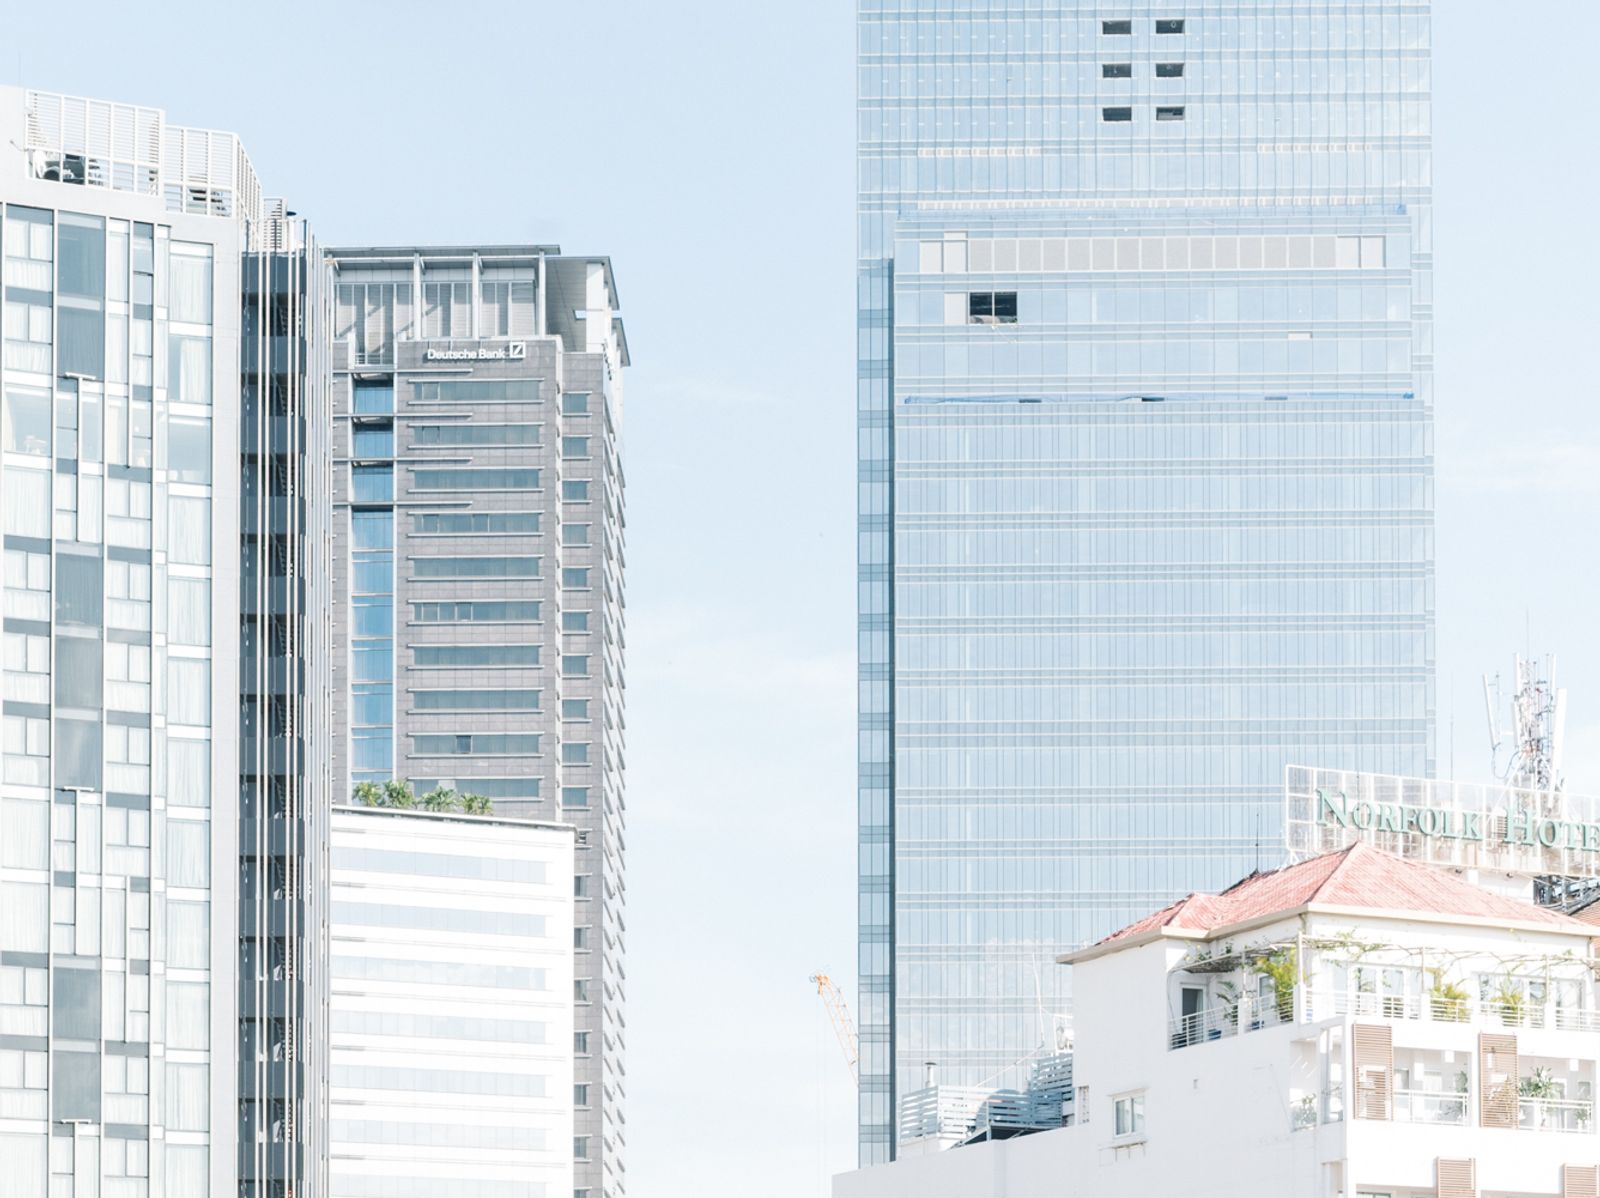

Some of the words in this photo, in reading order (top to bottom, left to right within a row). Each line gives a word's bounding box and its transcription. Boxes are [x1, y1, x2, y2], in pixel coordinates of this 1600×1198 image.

[427, 349, 477, 360] Deutsche
[479, 349, 506, 359] Bank
[1315, 788, 1482, 841] NORFOLK
